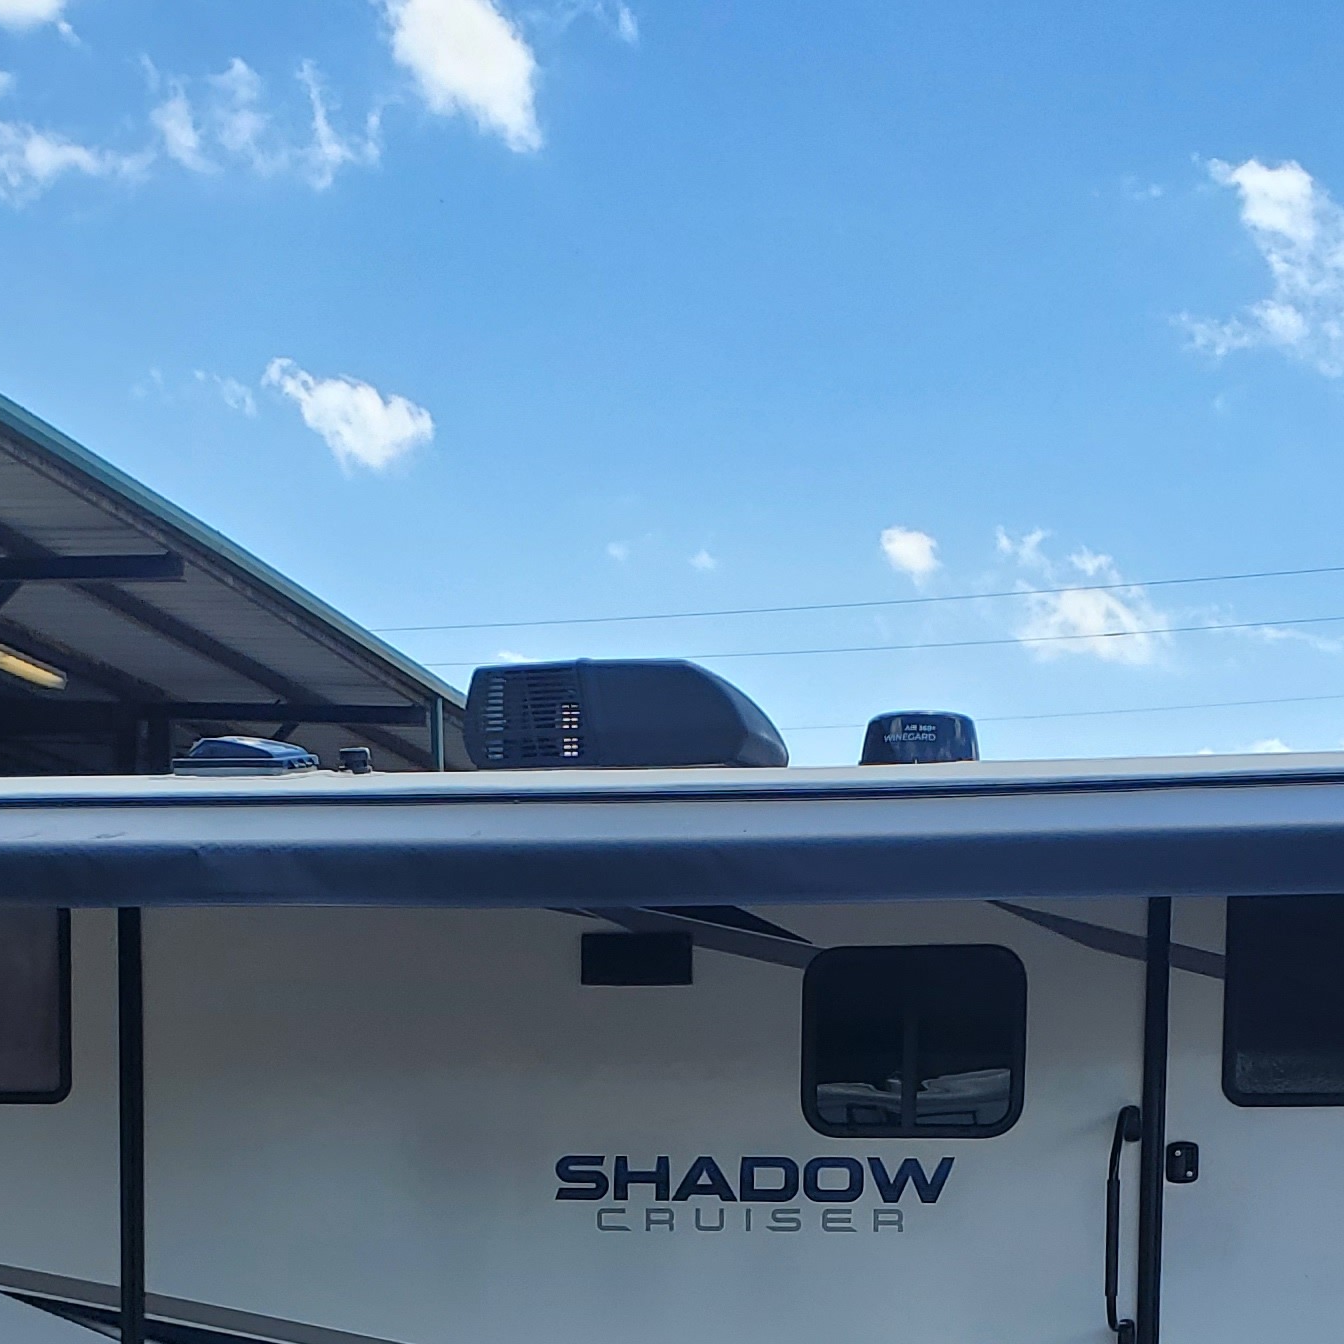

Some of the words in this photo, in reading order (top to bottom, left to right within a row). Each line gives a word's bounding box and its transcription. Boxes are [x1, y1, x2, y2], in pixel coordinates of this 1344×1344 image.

[884, 732, 936, 742] WINEGARD
[555, 1155, 955, 1203] SHADOW
[596, 1208, 904, 1233] CRUISER
